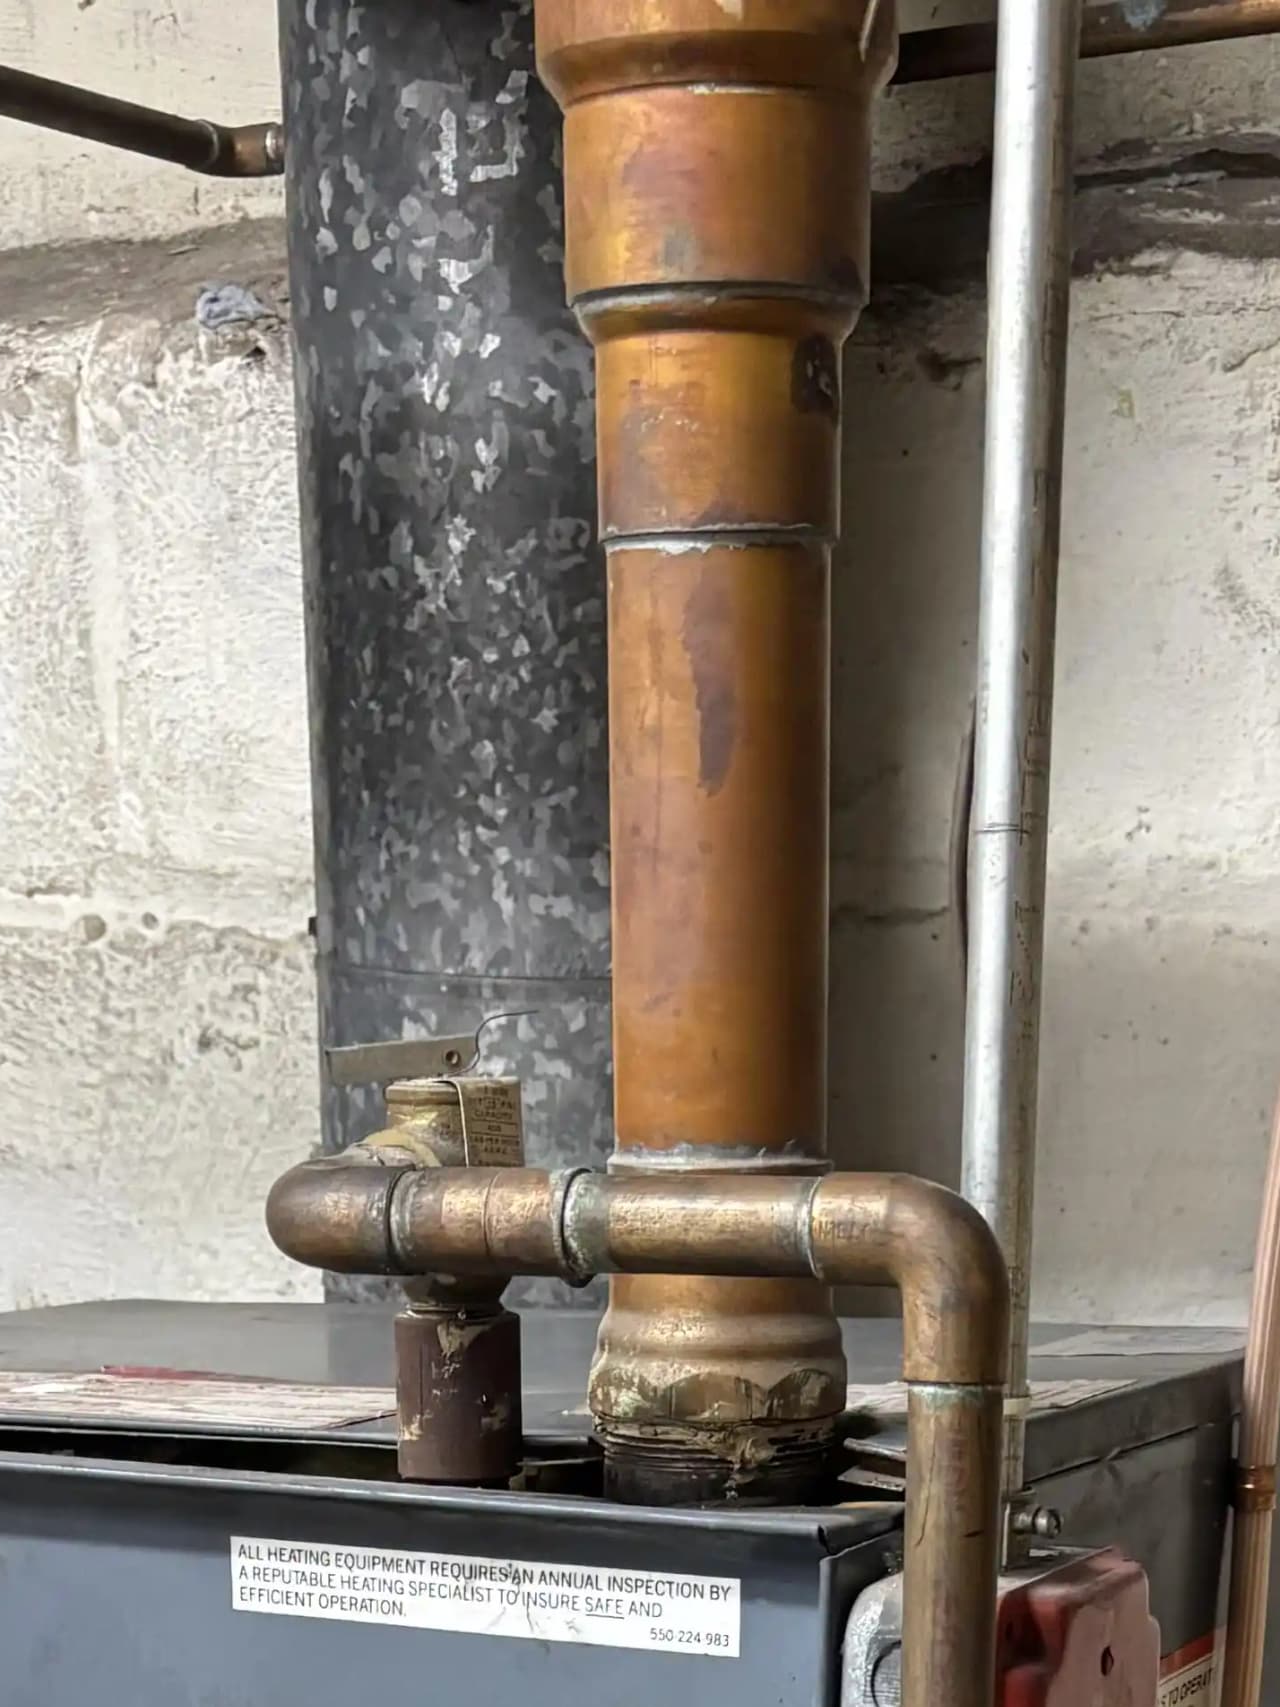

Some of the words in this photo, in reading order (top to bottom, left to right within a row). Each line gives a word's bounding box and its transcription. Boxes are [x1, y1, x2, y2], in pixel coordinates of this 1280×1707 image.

[238, 1544, 263, 1560] ALL
[267, 1548, 330, 1567] HEATING
[335, 1553, 425, 1575] EQUIPMENT
[430, 1561, 508, 1583] REQUIRES
[512, 1568, 534, 1585] AN
[538, 1570, 602, 1591] ANNUAL
[608, 1576, 704, 1600] INSPECTION
[710, 1584, 731, 1601] BY
[239, 1565, 249, 1580] A
[253, 1567, 336, 1589] REPUTABLE
[341, 1575, 404, 1595] HEATING
[408, 1580, 491, 1603] SPECIALIST
[500, 1589, 518, 1605] TO
[522, 1592, 581, 1612] INSURE
[585, 1596, 624, 1616] SAFE
[628, 1601, 662, 1618] AND
[240, 1587, 315, 1608] EFFICIENT
[318, 1593, 407, 1617] OPERATION.
